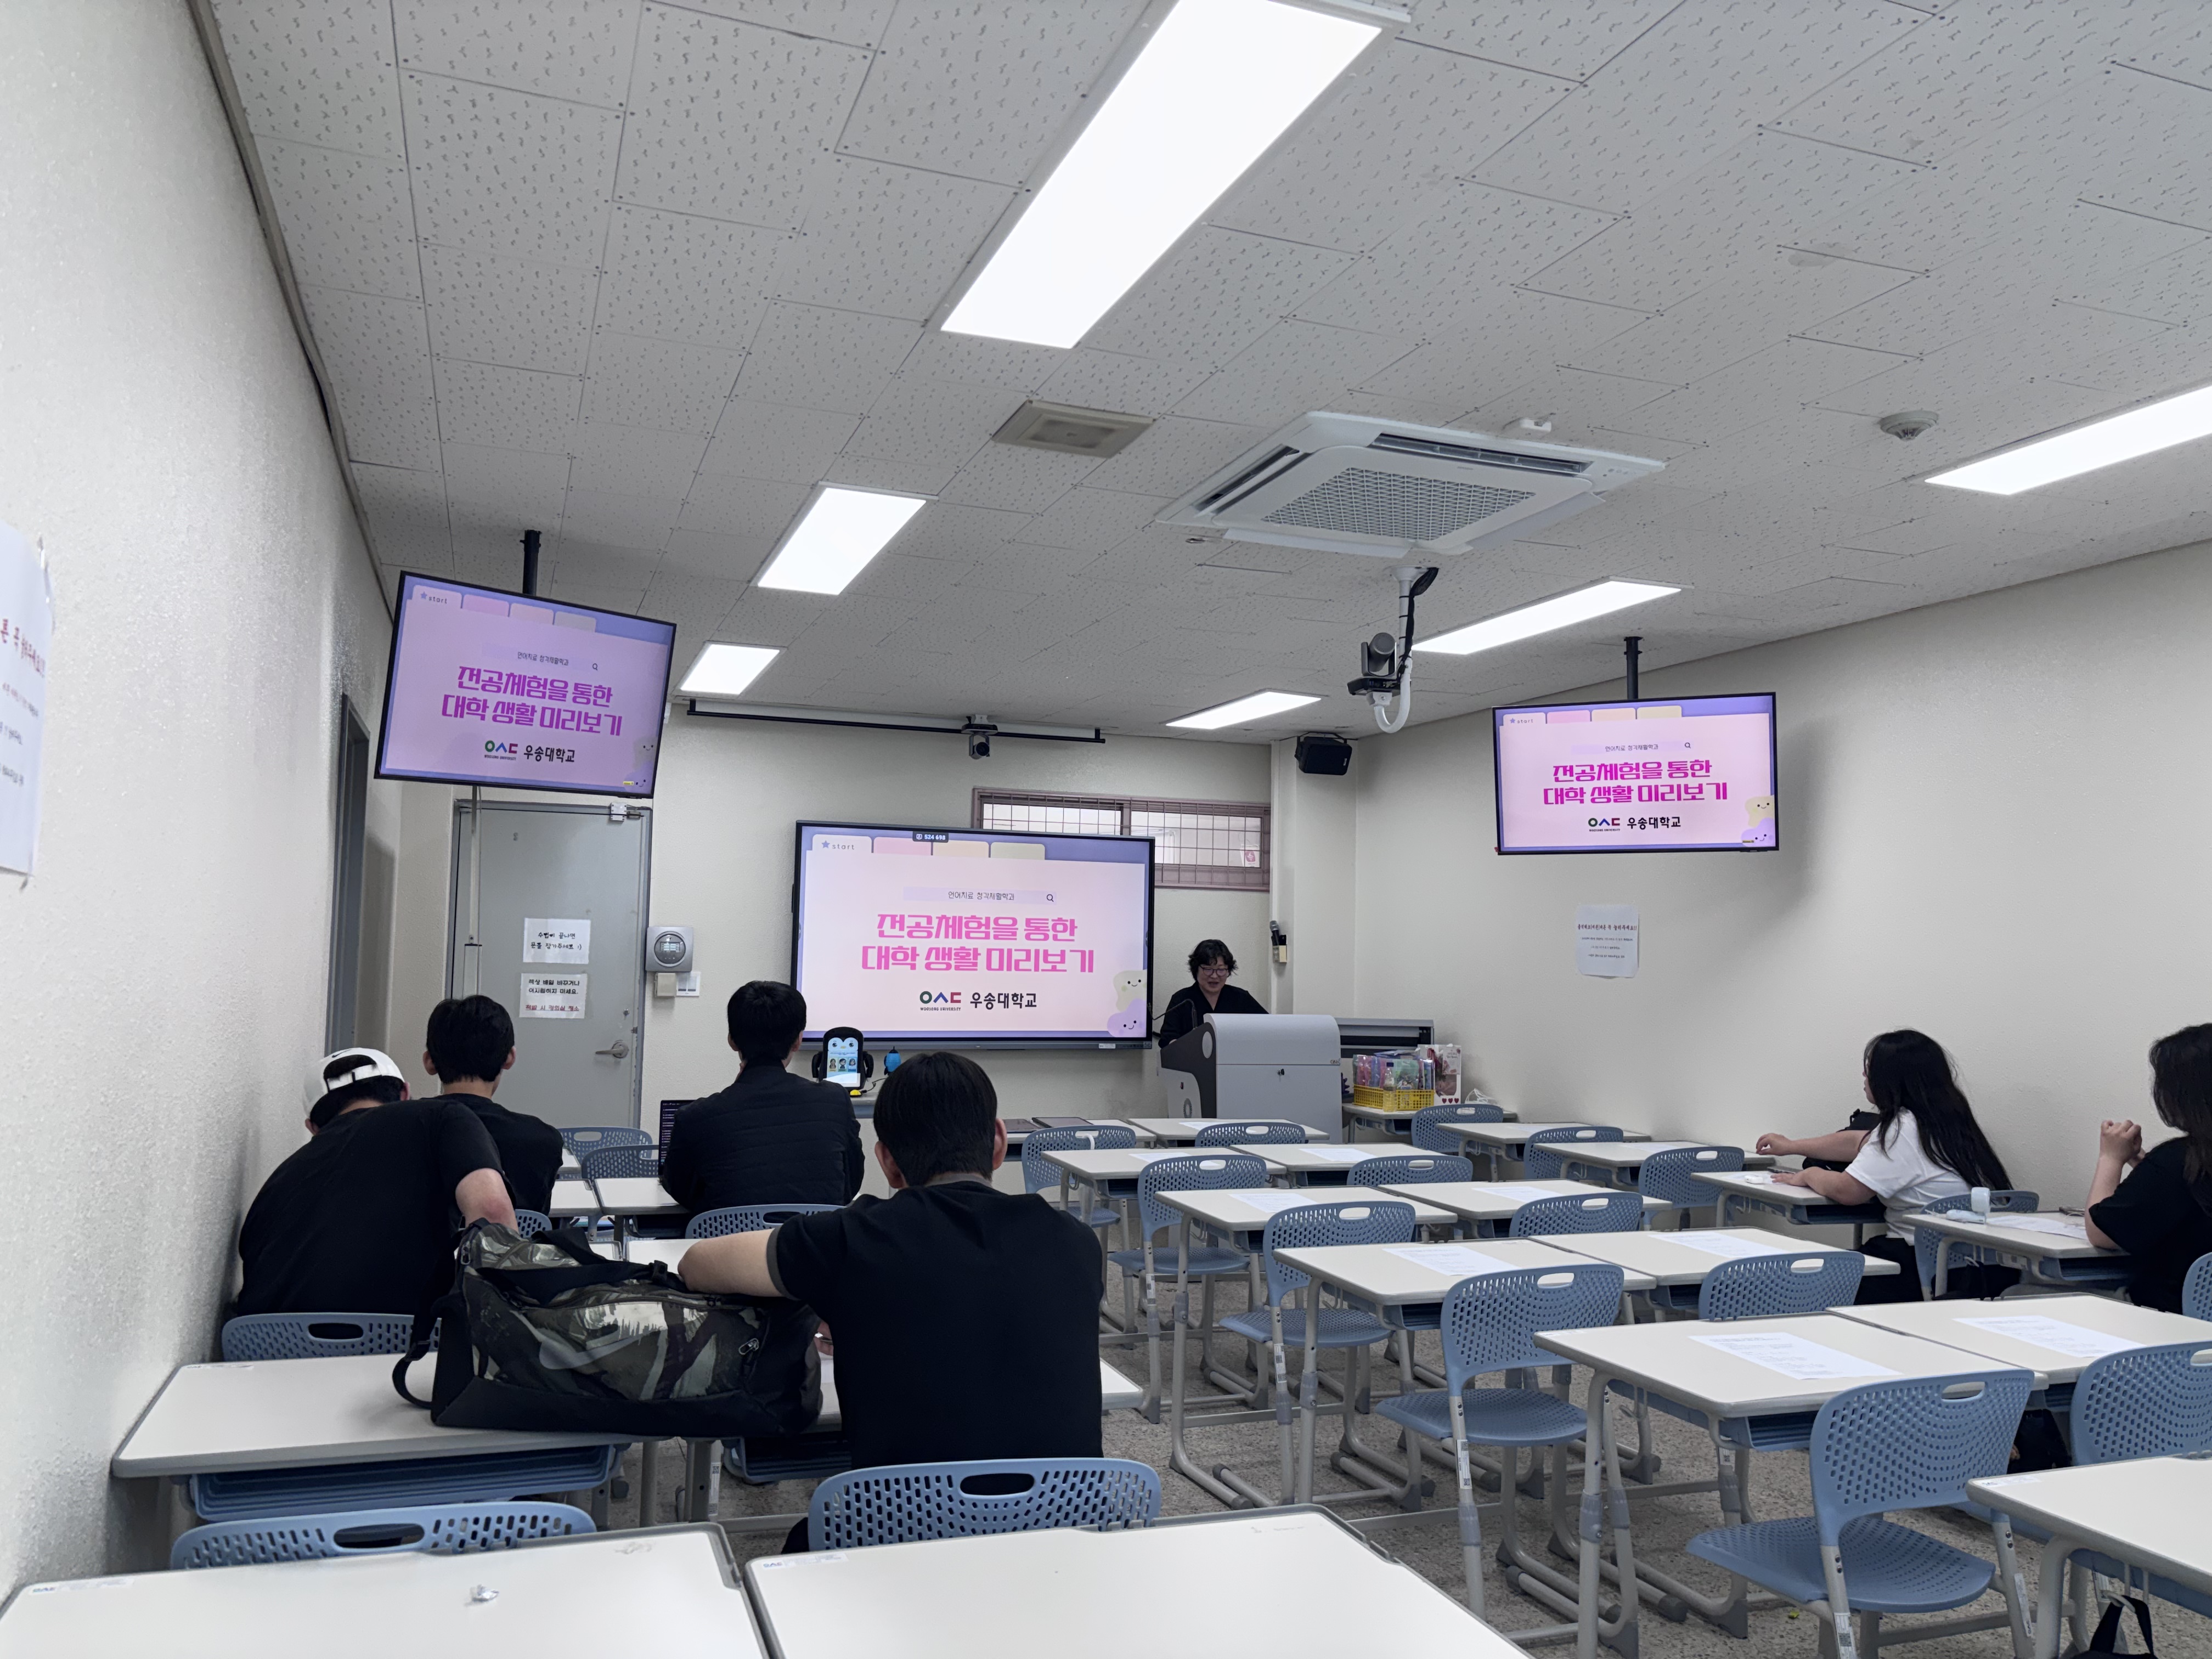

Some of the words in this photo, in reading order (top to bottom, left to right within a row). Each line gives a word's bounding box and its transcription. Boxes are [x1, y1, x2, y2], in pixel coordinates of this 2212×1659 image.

[428, 595, 447, 604] start
[458, 666, 569, 702] 전공체험을
[572, 682, 613, 708] 통한
[442, 694, 489, 721] 대학
[492, 701, 538, 726] 생활
[539, 706, 623, 736] 미리보기
[523, 745, 575, 763] 우송대학교
[1553, 761, 1663, 782] 전공체험을
[1667, 759, 1712, 778] 통한
[1543, 787, 1587, 805] 대학
[1590, 785, 1634, 804] 생활
[1638, 782, 1728, 802] 미리보기
[1627, 816, 1681, 830] 우송대학교
[948, 891, 974, 899] 언어치료
[877, 914, 1019, 941] 전공체험을
[1024, 917, 1078, 942] 통한
[862, 945, 920, 970] 대학
[924, 946, 981, 971] 생활
[986, 948, 1094, 973] 미리보기
[970, 992, 1037, 1010] 우송대학교
